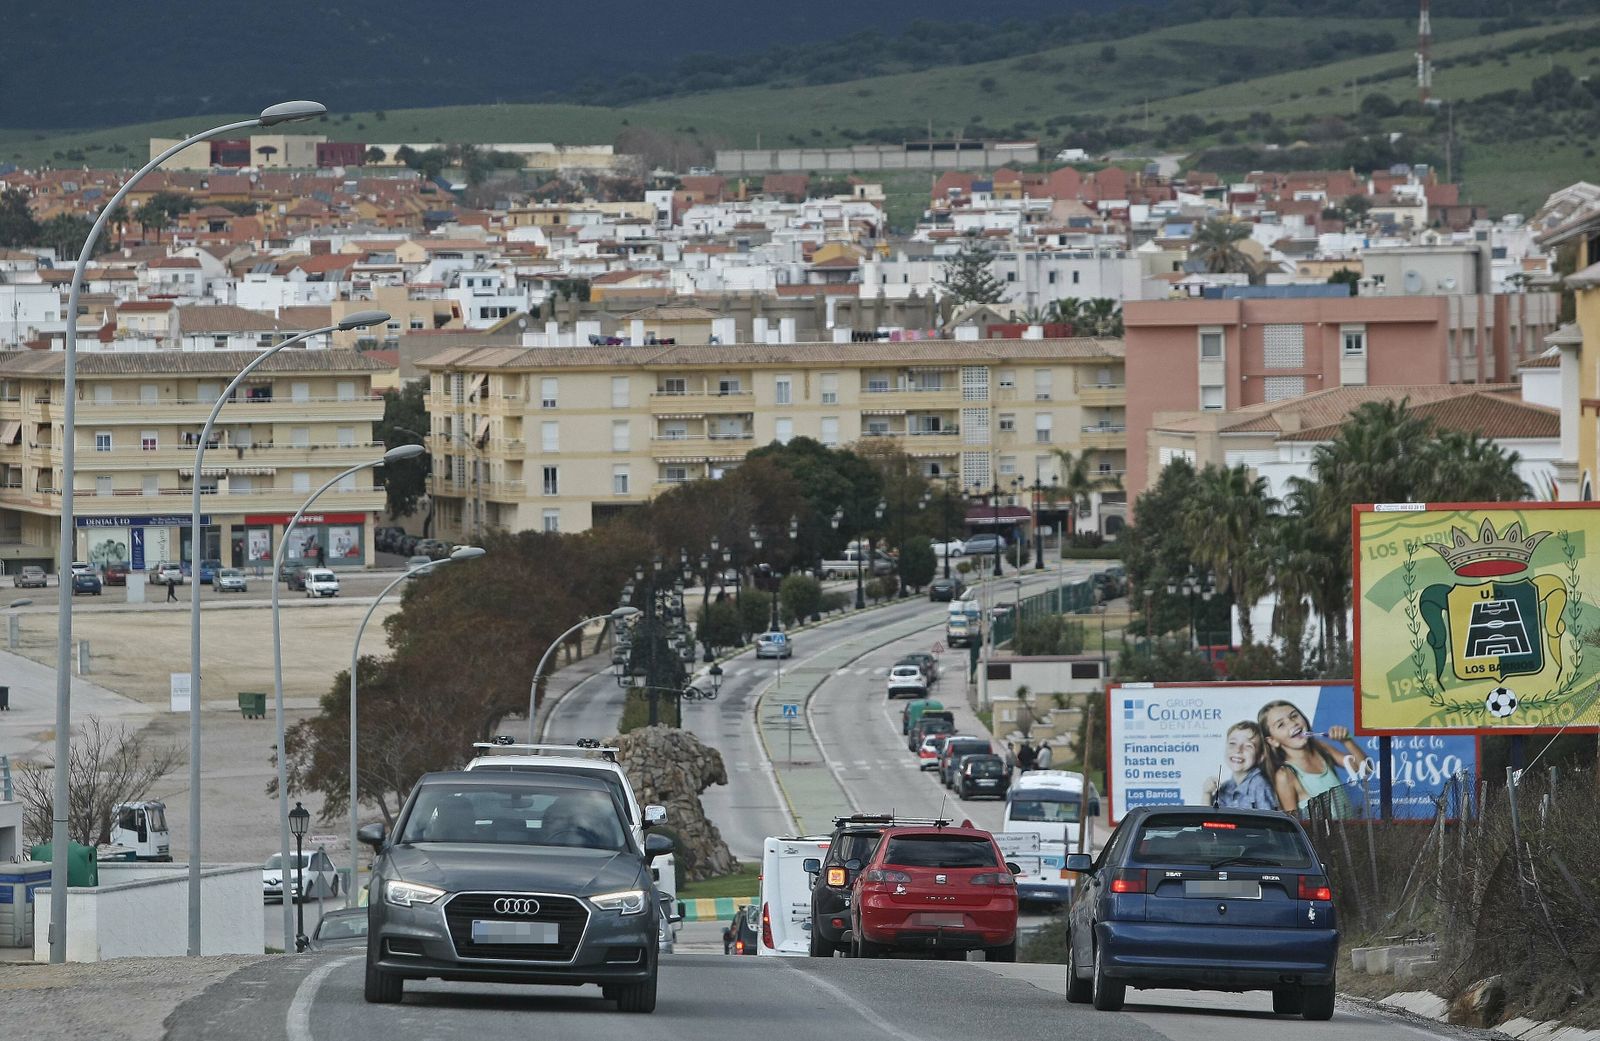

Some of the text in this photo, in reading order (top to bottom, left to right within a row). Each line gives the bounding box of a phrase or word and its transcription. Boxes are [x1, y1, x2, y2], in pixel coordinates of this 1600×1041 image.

[1368, 541, 1398, 560] LOS
[1465, 665, 1485, 674] LOS
[1166, 698, 1204, 708] GRUPO
[1147, 703, 1222, 721] COLOMER
[1160, 720, 1209, 730] DENTAL
[1124, 742, 1200, 753] Financiación
[1124, 756, 1175, 766] hasta en
[1125, 769, 1182, 779] 60 meses
[1128, 790, 1178, 799] Los Barrios
